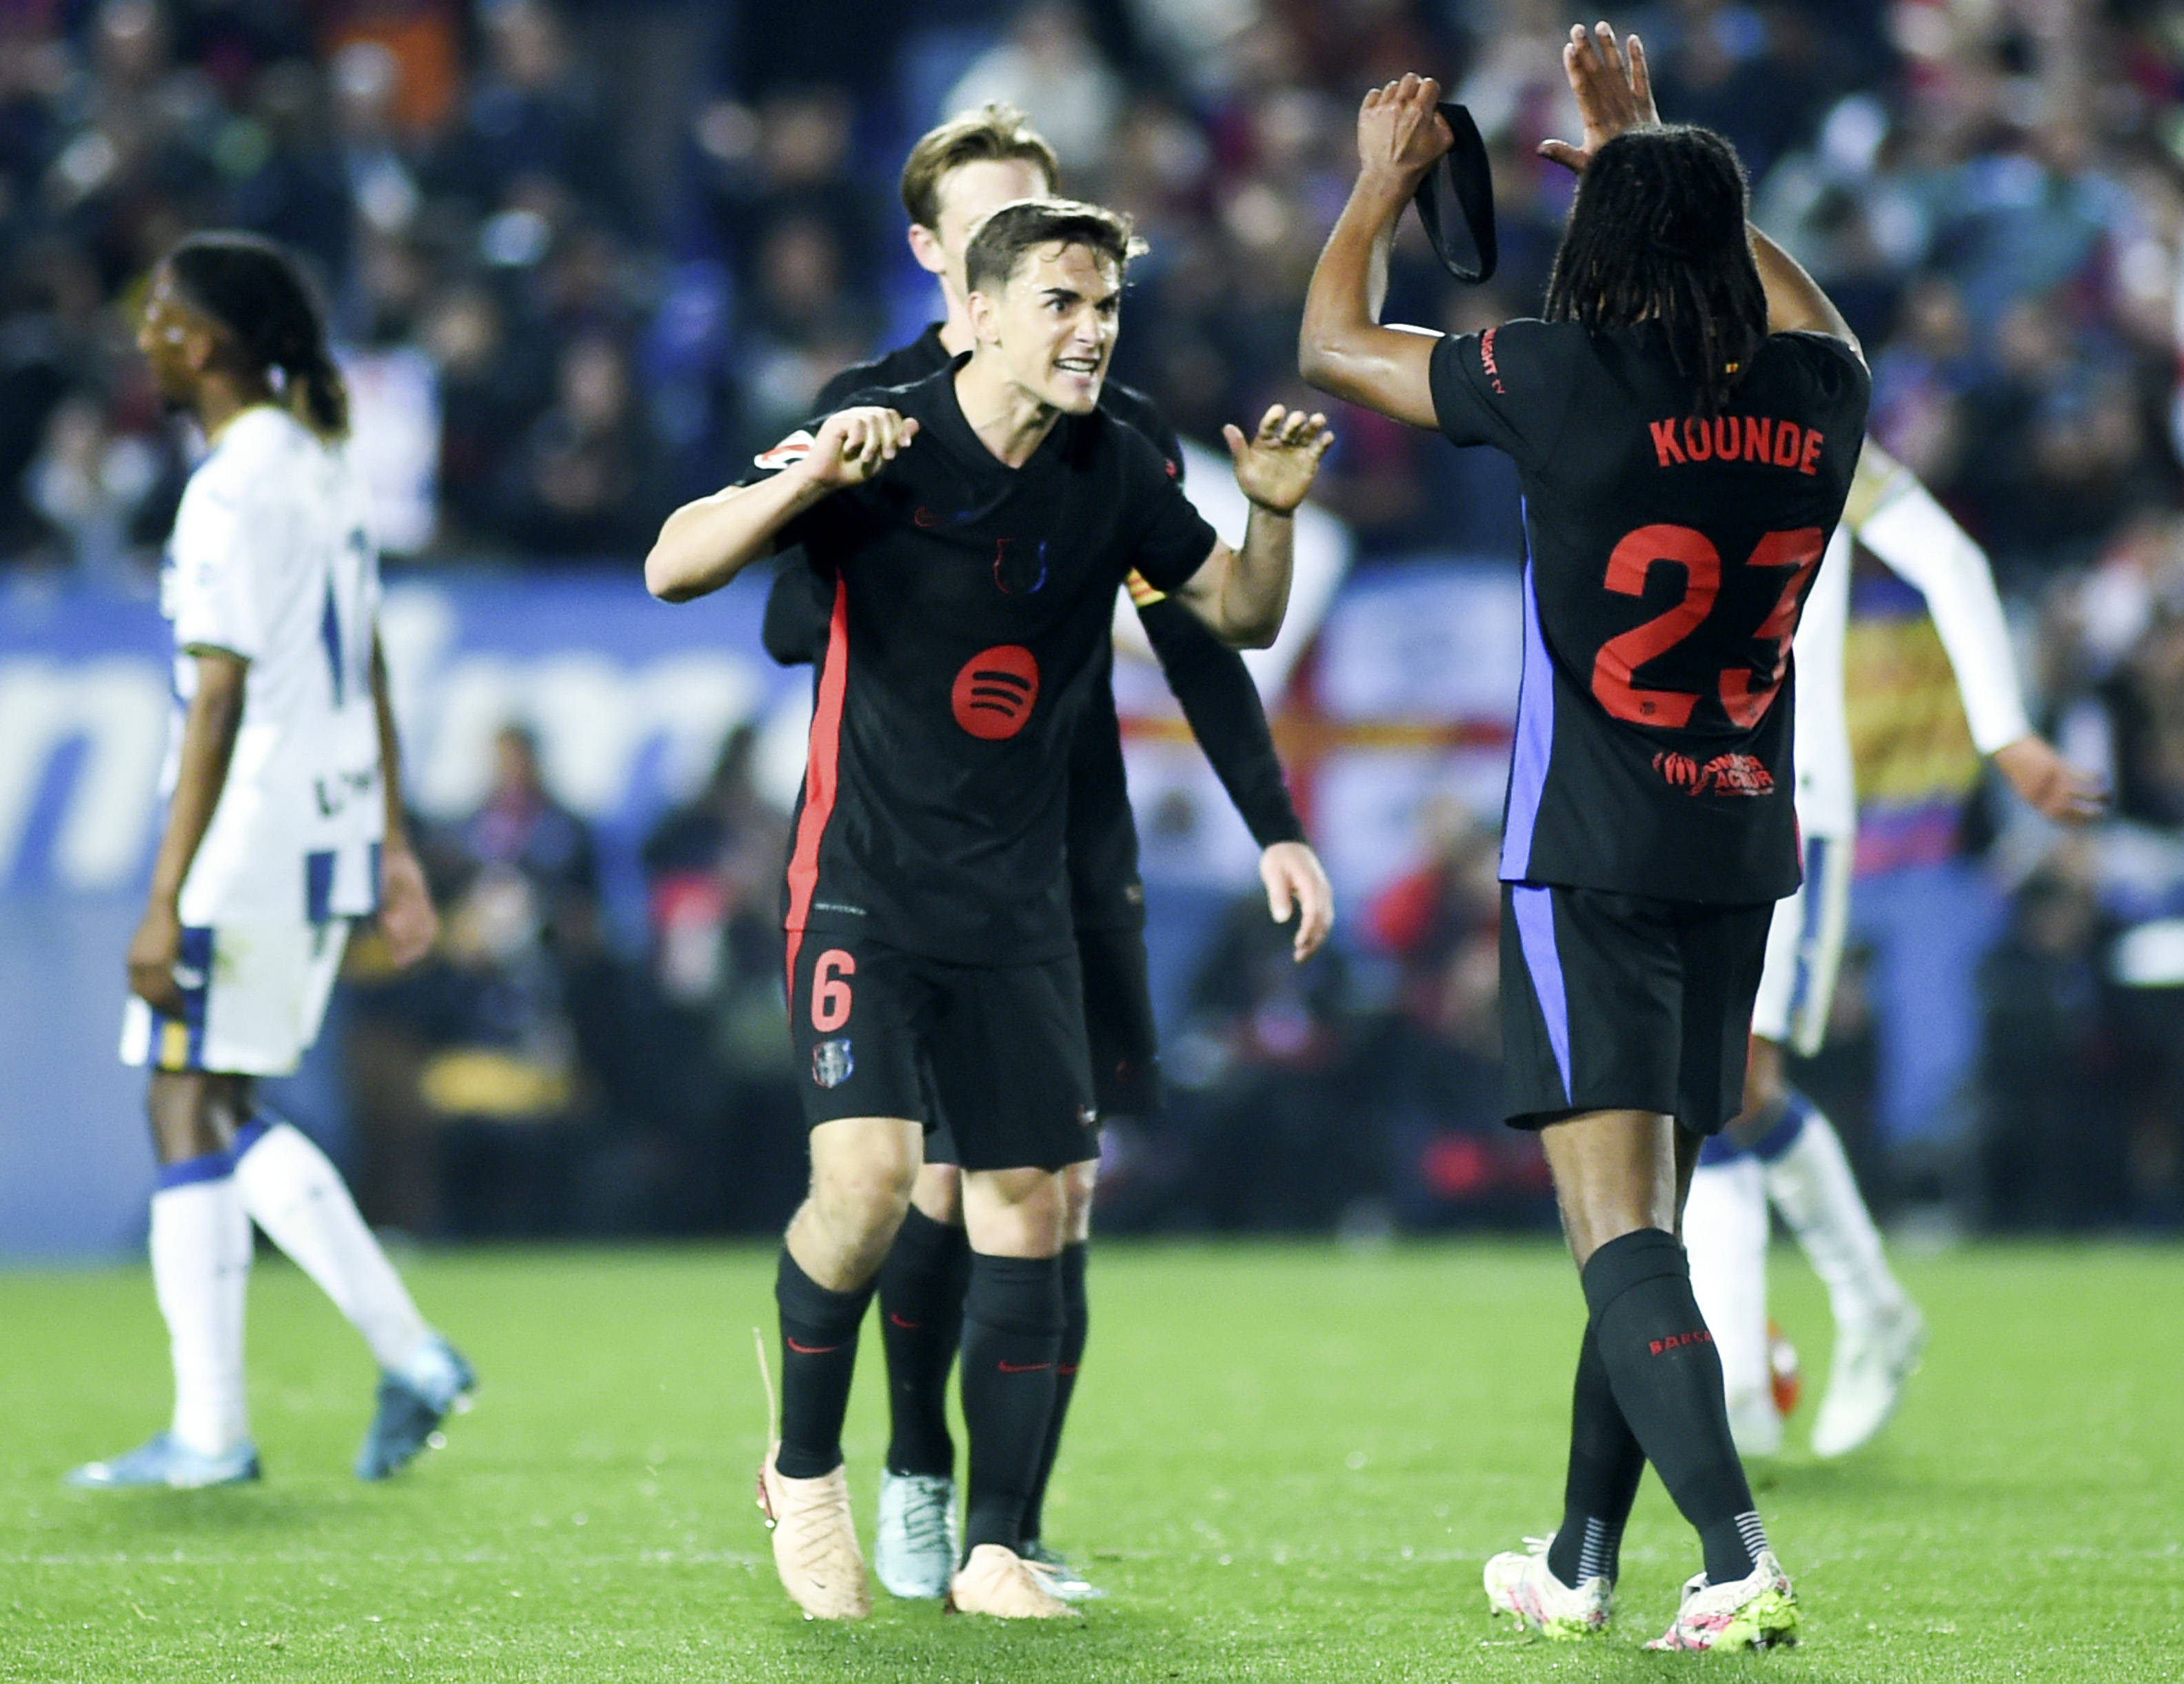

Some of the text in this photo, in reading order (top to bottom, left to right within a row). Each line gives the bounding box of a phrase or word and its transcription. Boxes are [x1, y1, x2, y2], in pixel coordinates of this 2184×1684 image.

[1649, 416, 1824, 477] KOUNDE
[1591, 523, 1824, 730] 23
[811, 948, 857, 1033] 6
